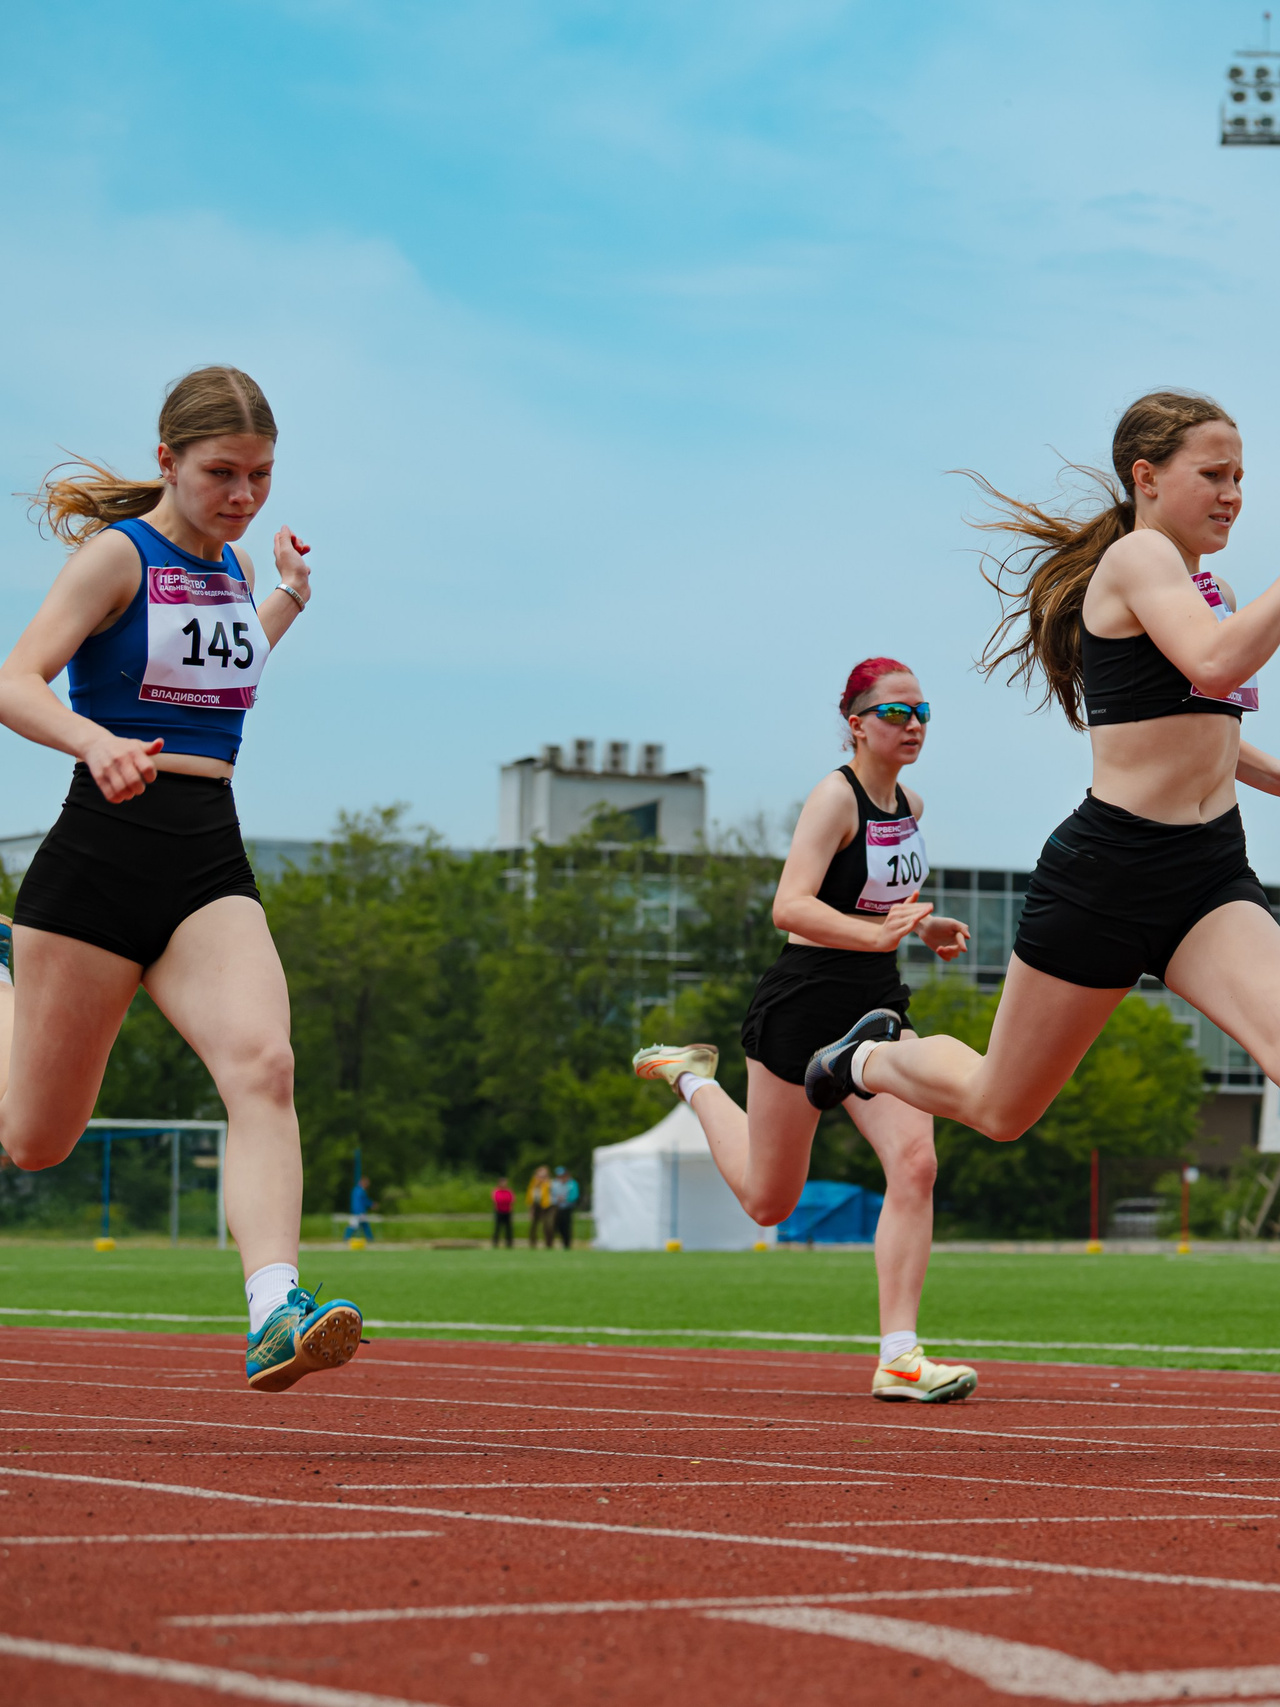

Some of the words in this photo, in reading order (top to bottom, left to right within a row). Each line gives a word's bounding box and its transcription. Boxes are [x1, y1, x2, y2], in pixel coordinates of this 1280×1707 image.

[182, 617, 253, 669] 145
[151, 688, 220, 704] ВЛАДИВОСТОК
[886, 851, 922, 887] 100
